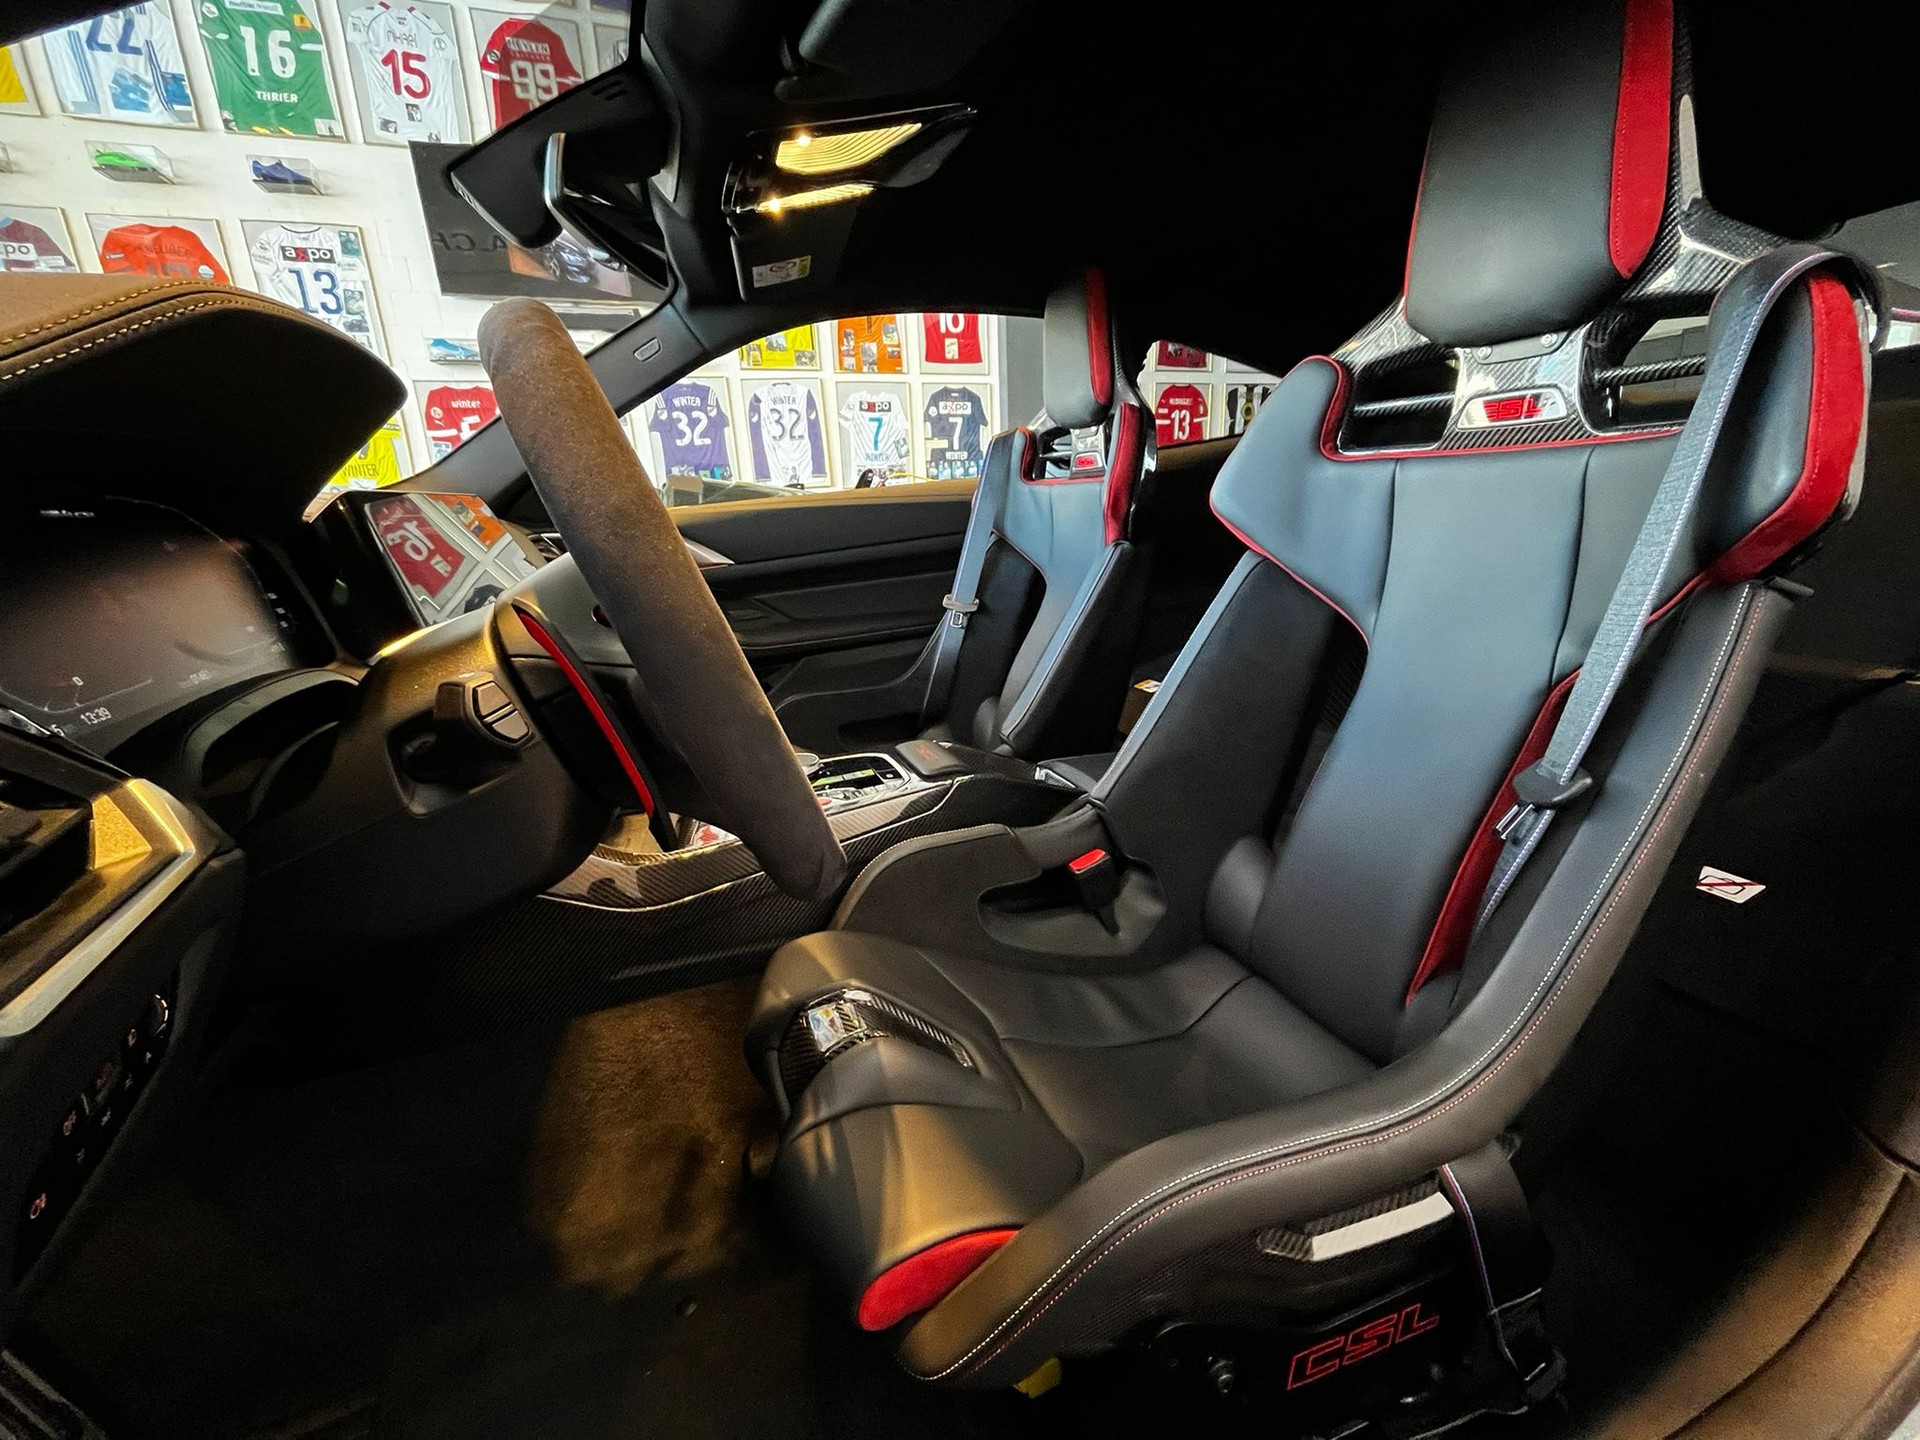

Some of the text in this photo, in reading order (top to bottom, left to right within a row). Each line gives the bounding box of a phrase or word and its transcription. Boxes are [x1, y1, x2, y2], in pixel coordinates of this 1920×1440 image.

[239, 25, 297, 79] 16
[380, 48, 431, 99] 15
[510, 60, 559, 101] 99
[255, 90, 299, 103] THRIER
[0, 244, 30, 258] po
[287, 268, 343, 315] 13
[451, 399, 481, 409] winter
[672, 395, 701, 408] WINTER
[771, 395, 797, 406] WINTER
[671, 410, 712, 447] 32
[769, 408, 806, 441] 32
[868, 416, 884, 452] 7
[948, 416, 964, 451] 7
[1170, 408, 1191, 440] 13
[80, 706, 112, 726] 13:39
[1286, 1302, 1440, 1391] CSL
